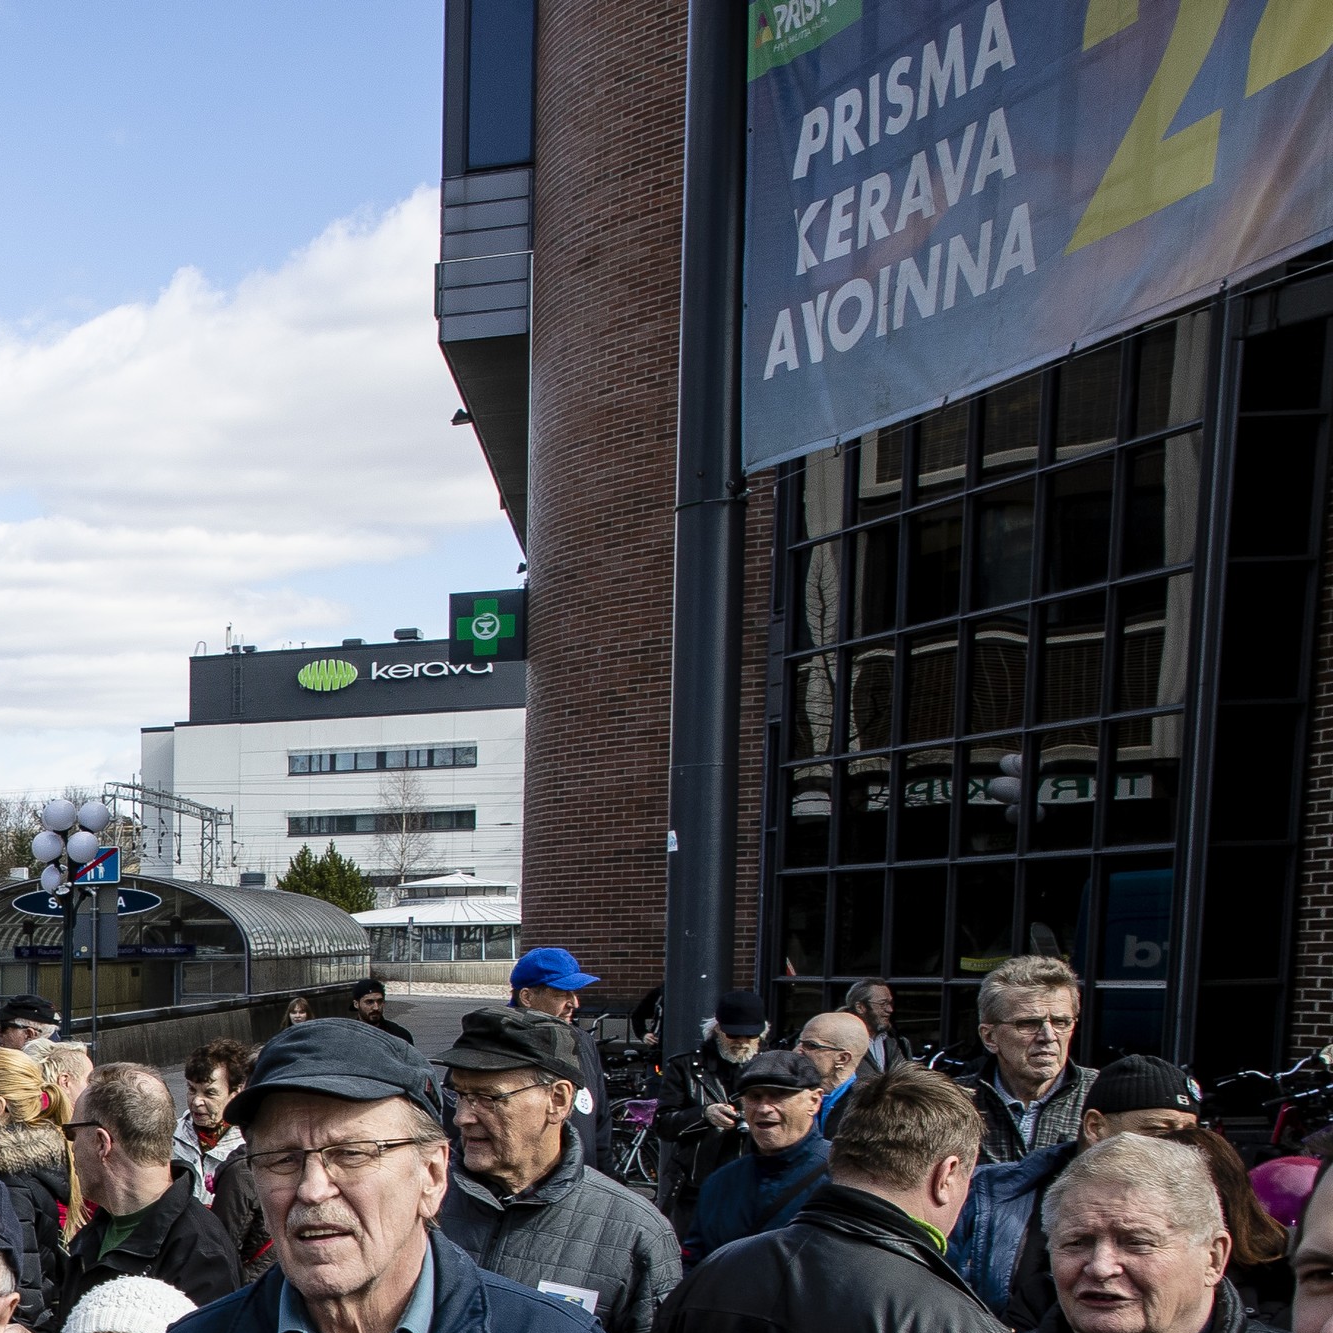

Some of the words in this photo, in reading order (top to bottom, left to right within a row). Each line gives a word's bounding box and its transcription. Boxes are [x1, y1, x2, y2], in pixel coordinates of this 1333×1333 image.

[792, 0, 1016, 181] PRISMA
[794, 107, 1017, 276] KERAVA
[763, 202, 1036, 380] AVOINNA
[371, 660, 494, 681] kerava
